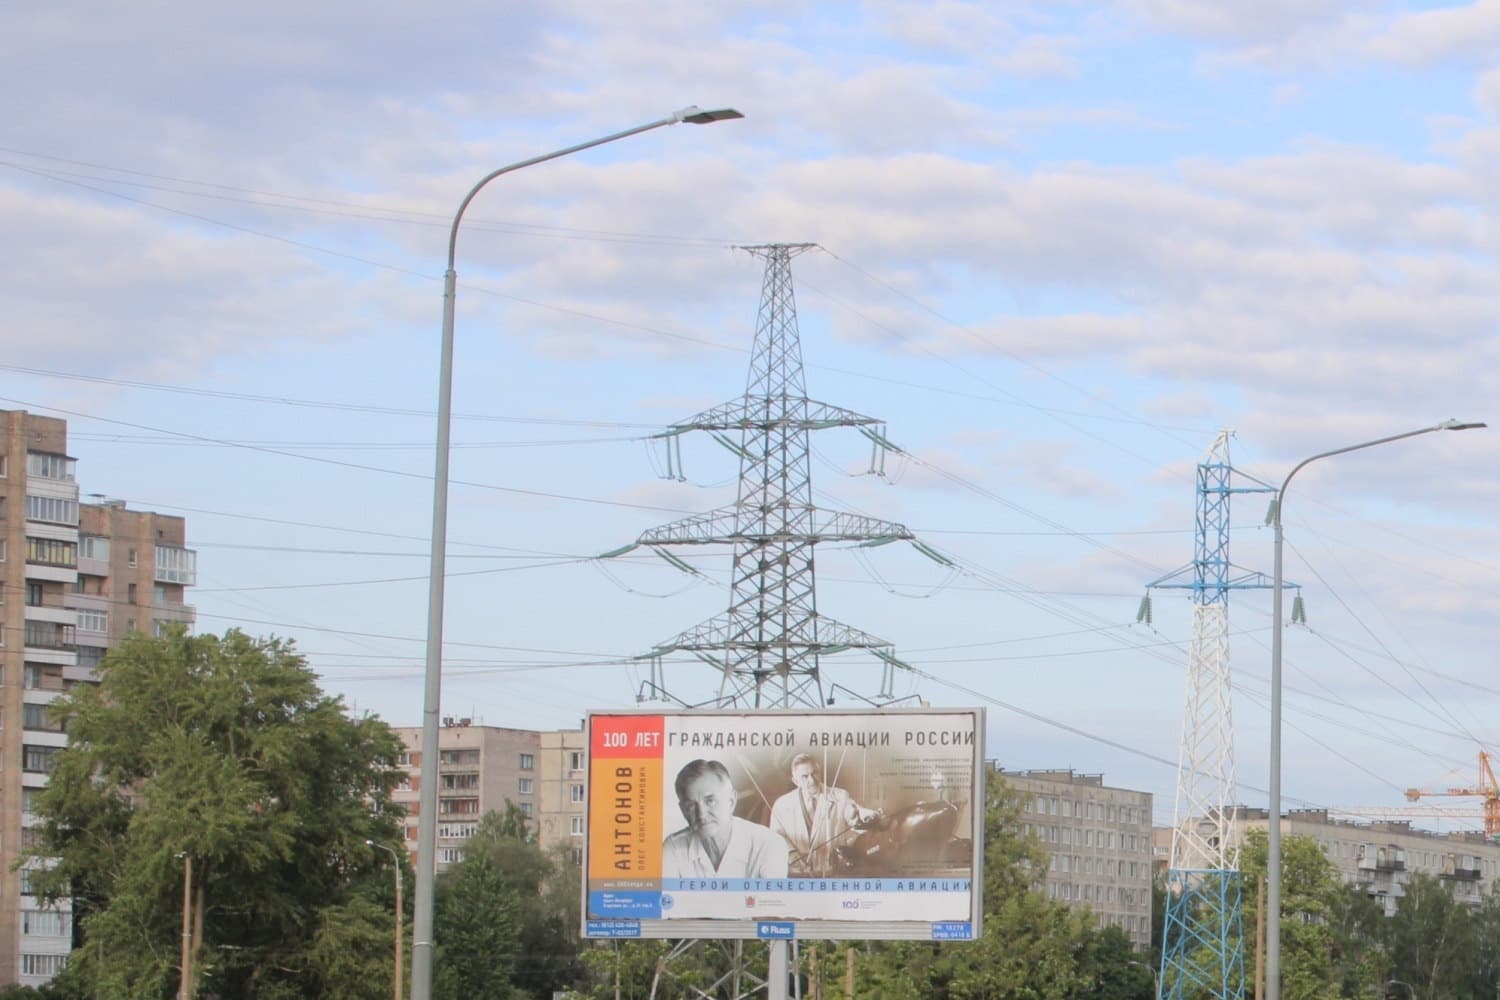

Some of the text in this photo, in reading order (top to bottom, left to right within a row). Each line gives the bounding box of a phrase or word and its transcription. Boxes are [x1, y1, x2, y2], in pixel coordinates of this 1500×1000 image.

[603, 732, 660, 748] 100 ЛЕТ
[668, 728, 974, 749] ГРАЖДАНСКОЙ АВИАЦИИ РОССИИ
[614, 767, 632, 870] АНТОНОВ
[679, 880, 971, 891] ГЕРОИ ОТЕЧЕСТВЕННОЙ АВИАЦИИ
[770, 926, 791, 934] Russ
